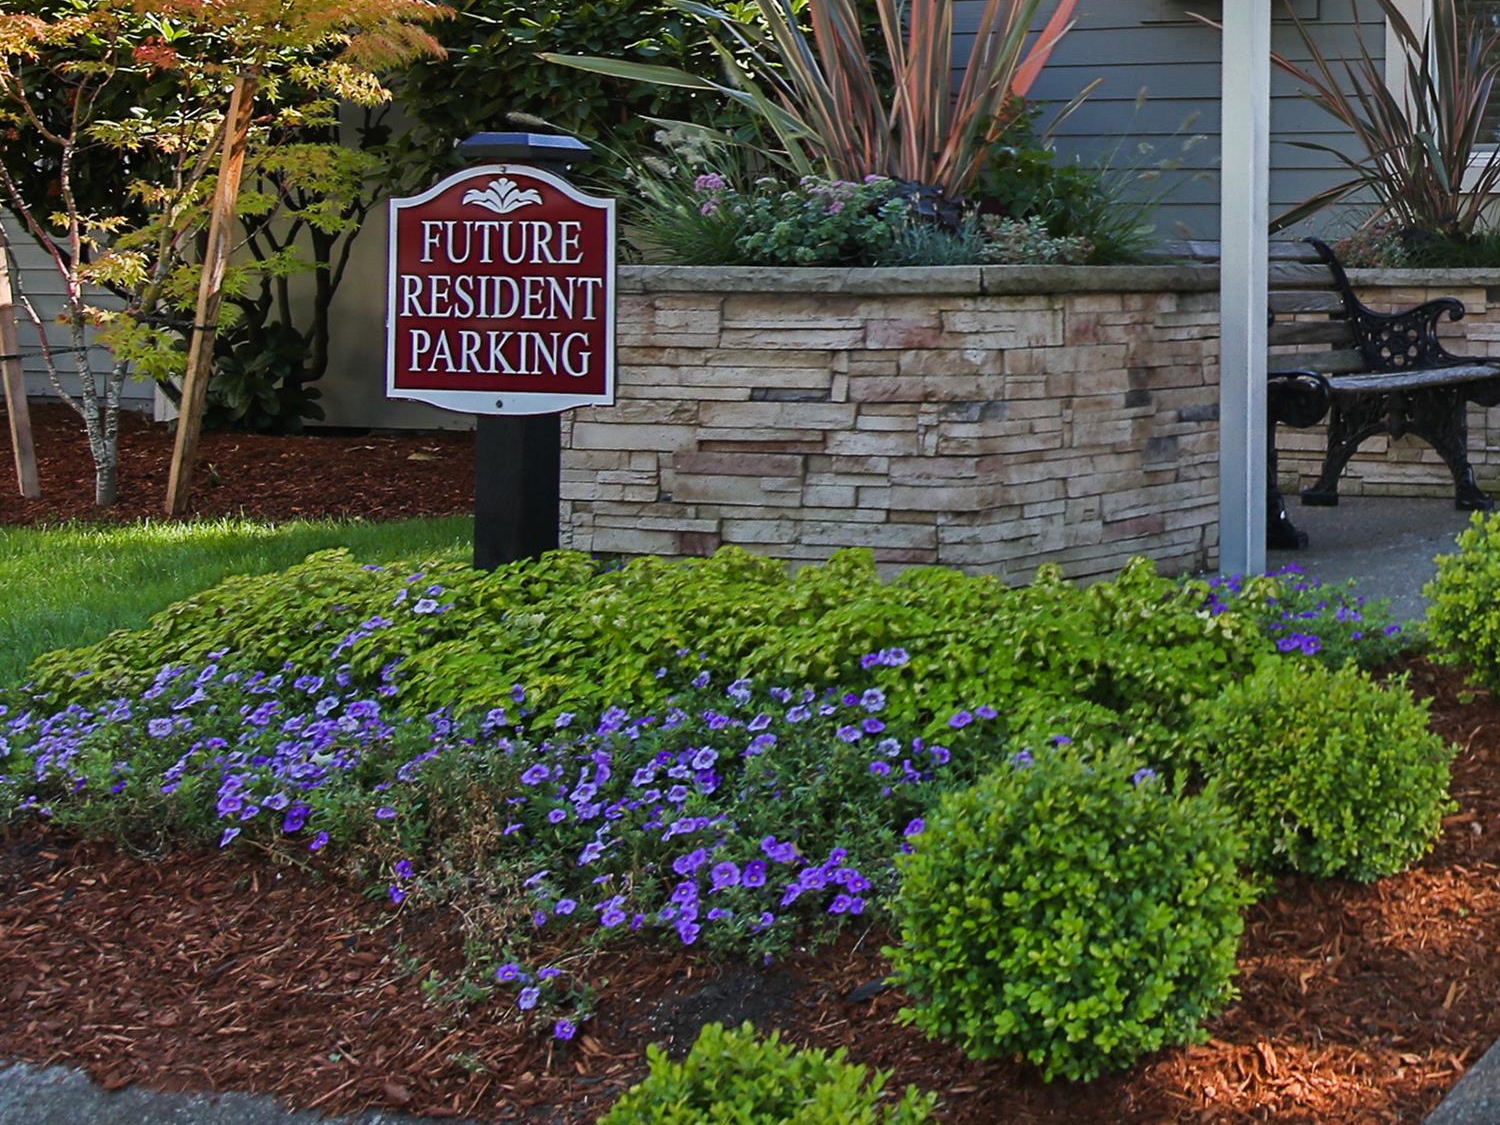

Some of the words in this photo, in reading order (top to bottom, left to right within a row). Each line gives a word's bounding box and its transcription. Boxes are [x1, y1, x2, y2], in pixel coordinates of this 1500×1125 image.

[420, 220, 584, 265] FUTURE
[400, 275, 603, 321] RESIDENT
[408, 329, 592, 377] PARKING
